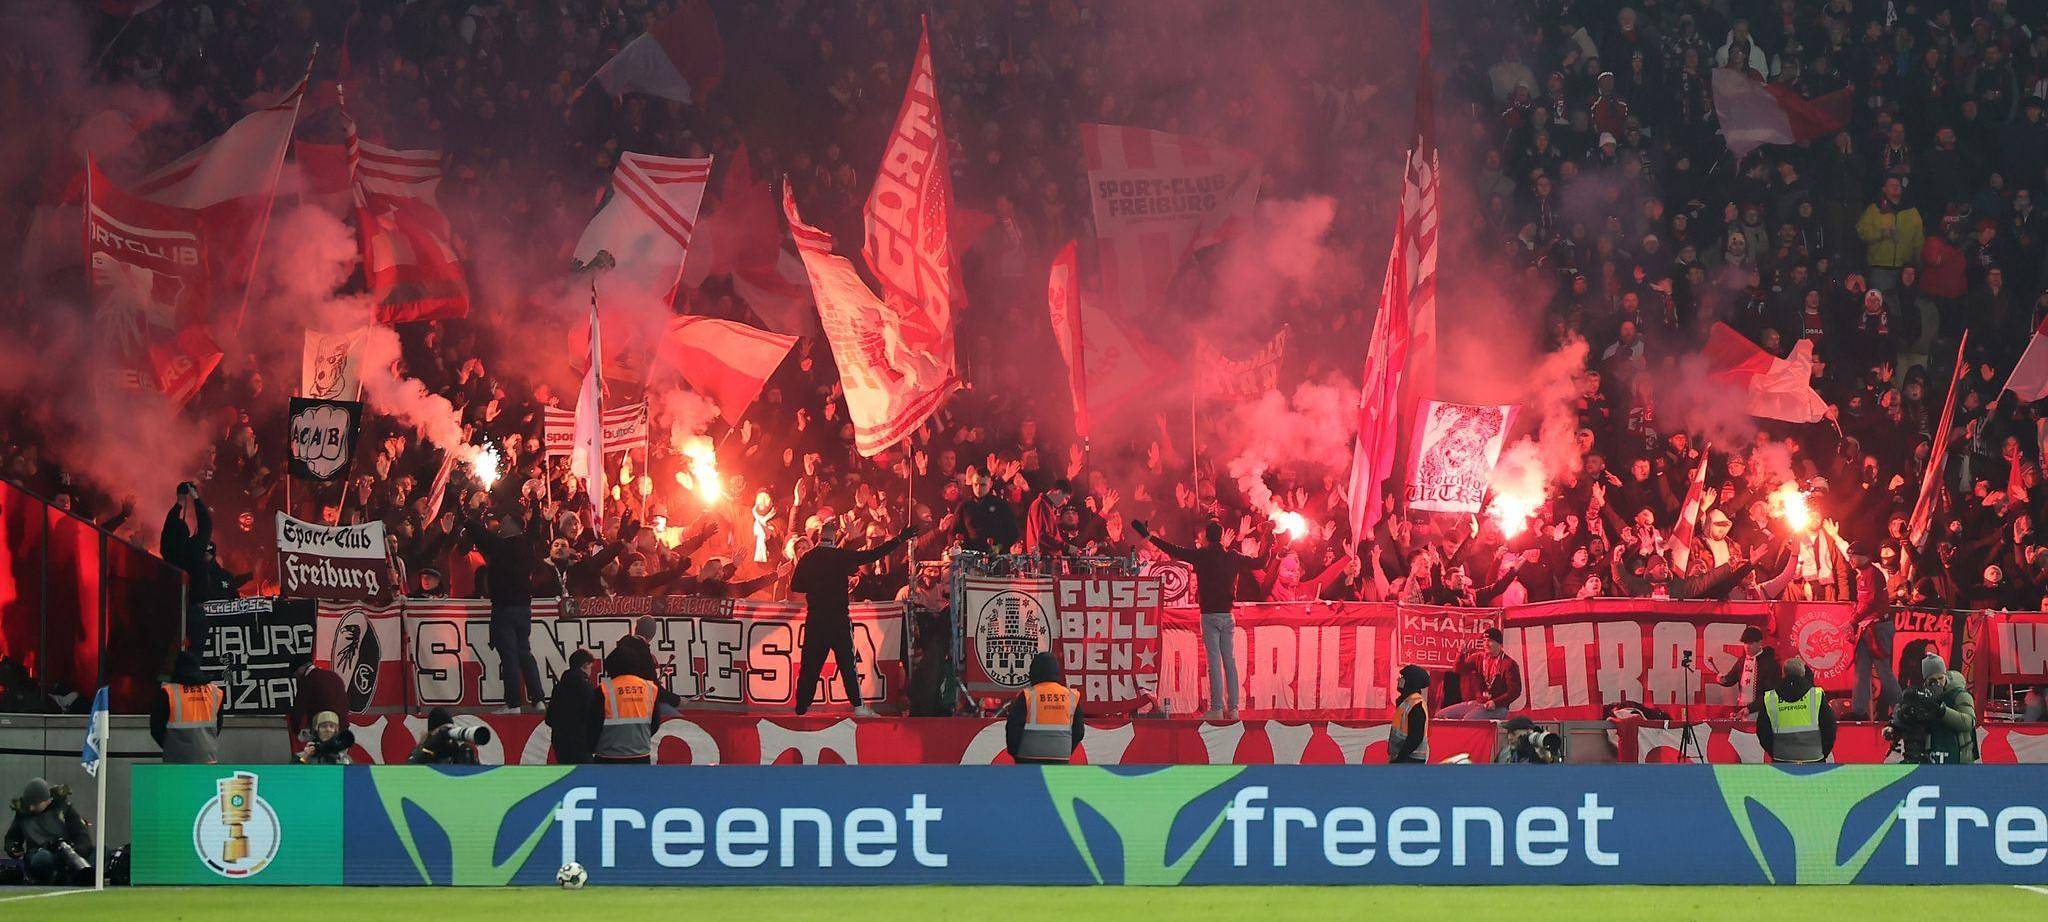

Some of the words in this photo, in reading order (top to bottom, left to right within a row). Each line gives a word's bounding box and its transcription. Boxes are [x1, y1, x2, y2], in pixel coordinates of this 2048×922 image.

[1100, 174, 1225, 199] SPORT-CLUB
[1108, 194, 1217, 217] FREIBURG
[292, 427, 340, 446] ACAB
[547, 432, 576, 443] spor
[284, 520, 371, 549] Sport-Club
[286, 554, 380, 595] Freiburg
[1060, 580, 1159, 608] FUSS
[1061, 611, 1158, 639] BALL
[1404, 615, 1495, 634] KHALID
[1895, 610, 1953, 632] ULTRAS
[1441, 637, 1486, 650] IMME
[417, 619, 886, 703] SYNTHESA
[1063, 642, 1133, 671] DEN
[1416, 653, 1441, 662] BEI
[618, 686, 645, 695] BEST
[1040, 694, 1066, 702] BEST
[556, 787, 948, 867] freenet
[1227, 786, 1620, 866] freenet
[1899, 785, 2048, 866] fre
